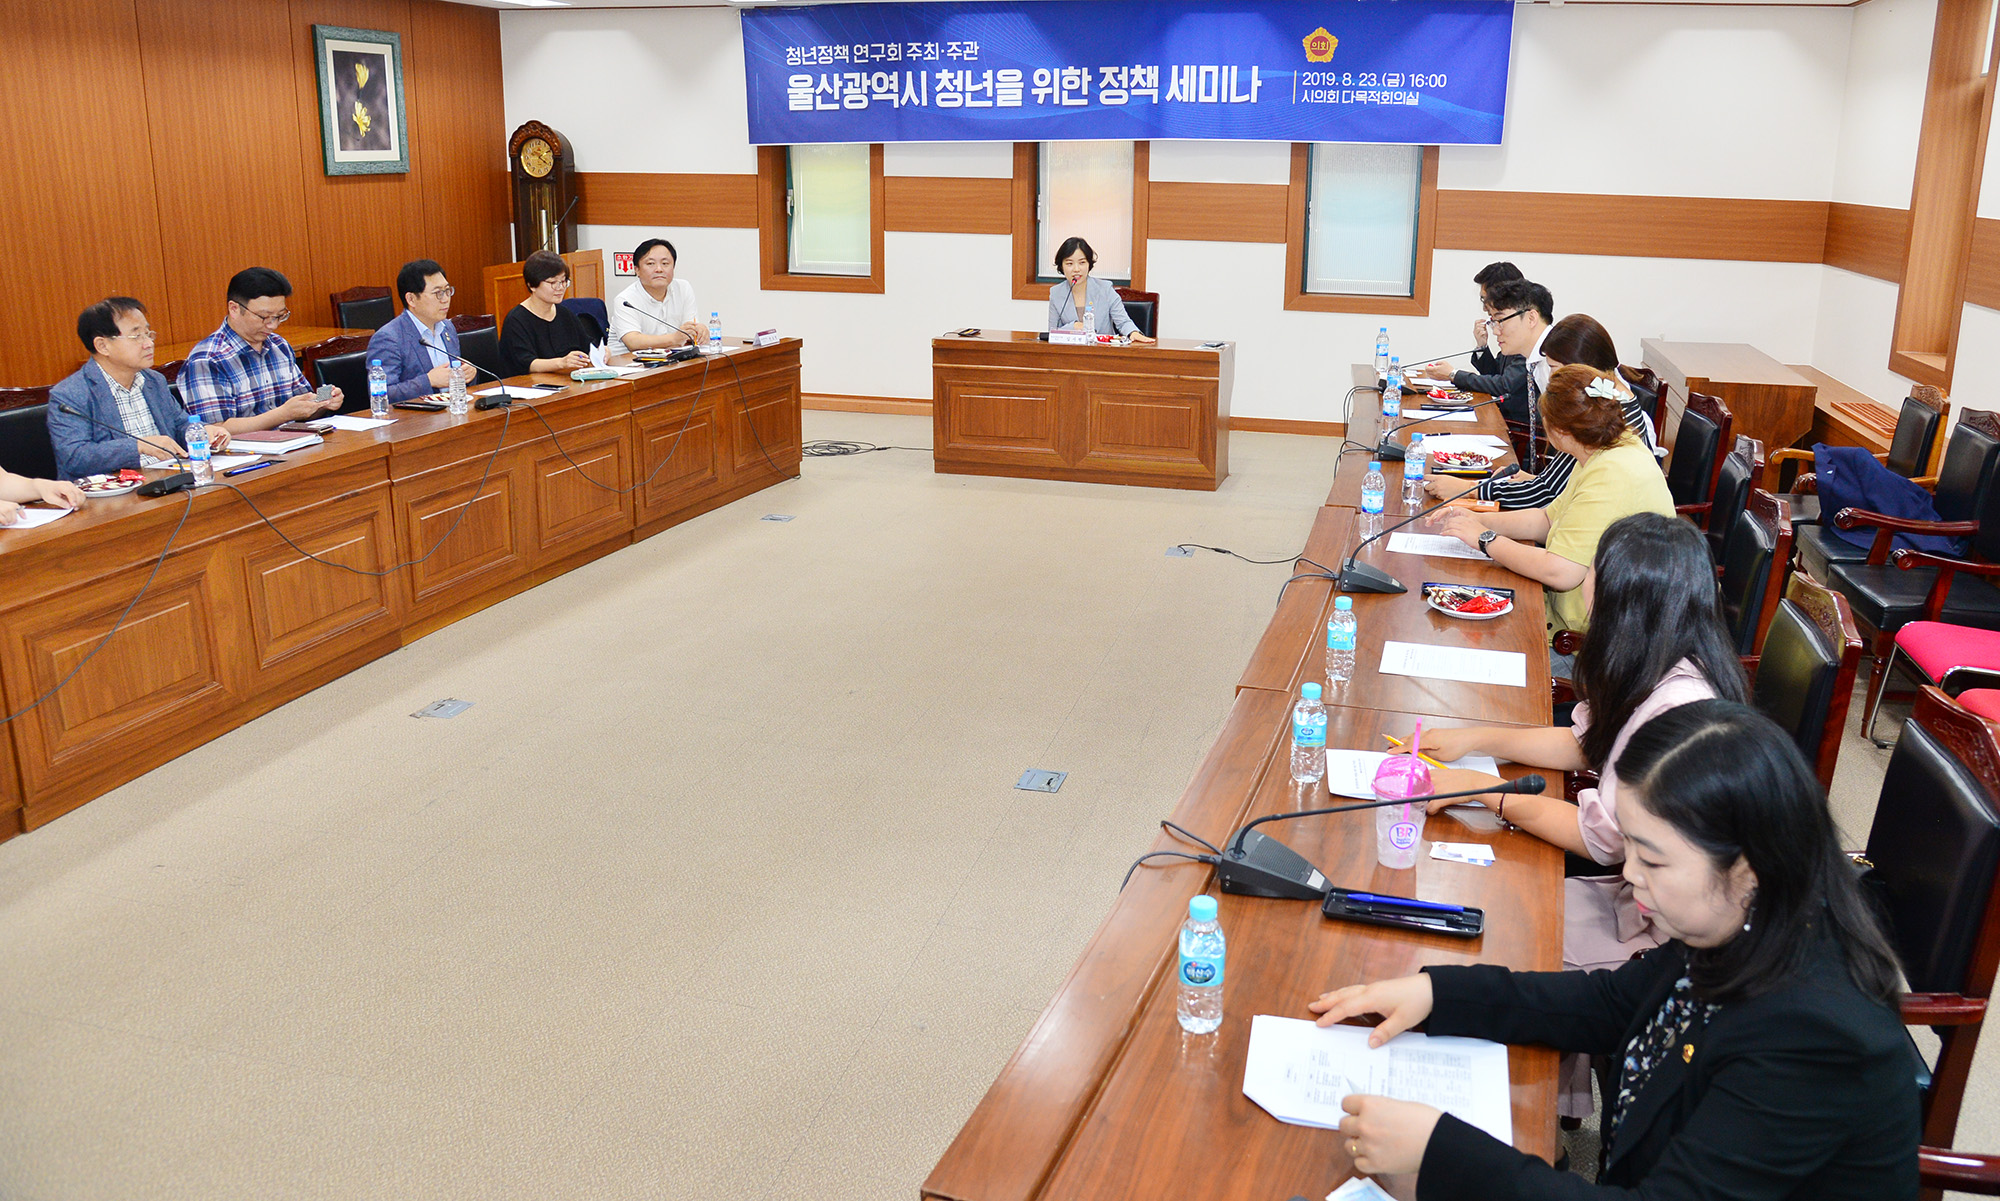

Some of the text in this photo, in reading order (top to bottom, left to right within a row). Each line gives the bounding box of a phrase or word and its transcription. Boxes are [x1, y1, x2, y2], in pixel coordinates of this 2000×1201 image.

[786, 41, 980, 66] 청년정책 연구회 주최·주관
[1311, 41, 1329, 51] 의회
[787, 65, 1263, 111] 울산광역시 청년을 위한 정책 세미나
[1302, 72, 1339, 87] 2019.
[1342, 72, 1355, 87] 8.
[1409, 73, 1447, 88] 16:00
[1301, 89, 1420, 106] 시의회 다목적회의실
[1396, 826, 1413, 838] BR
